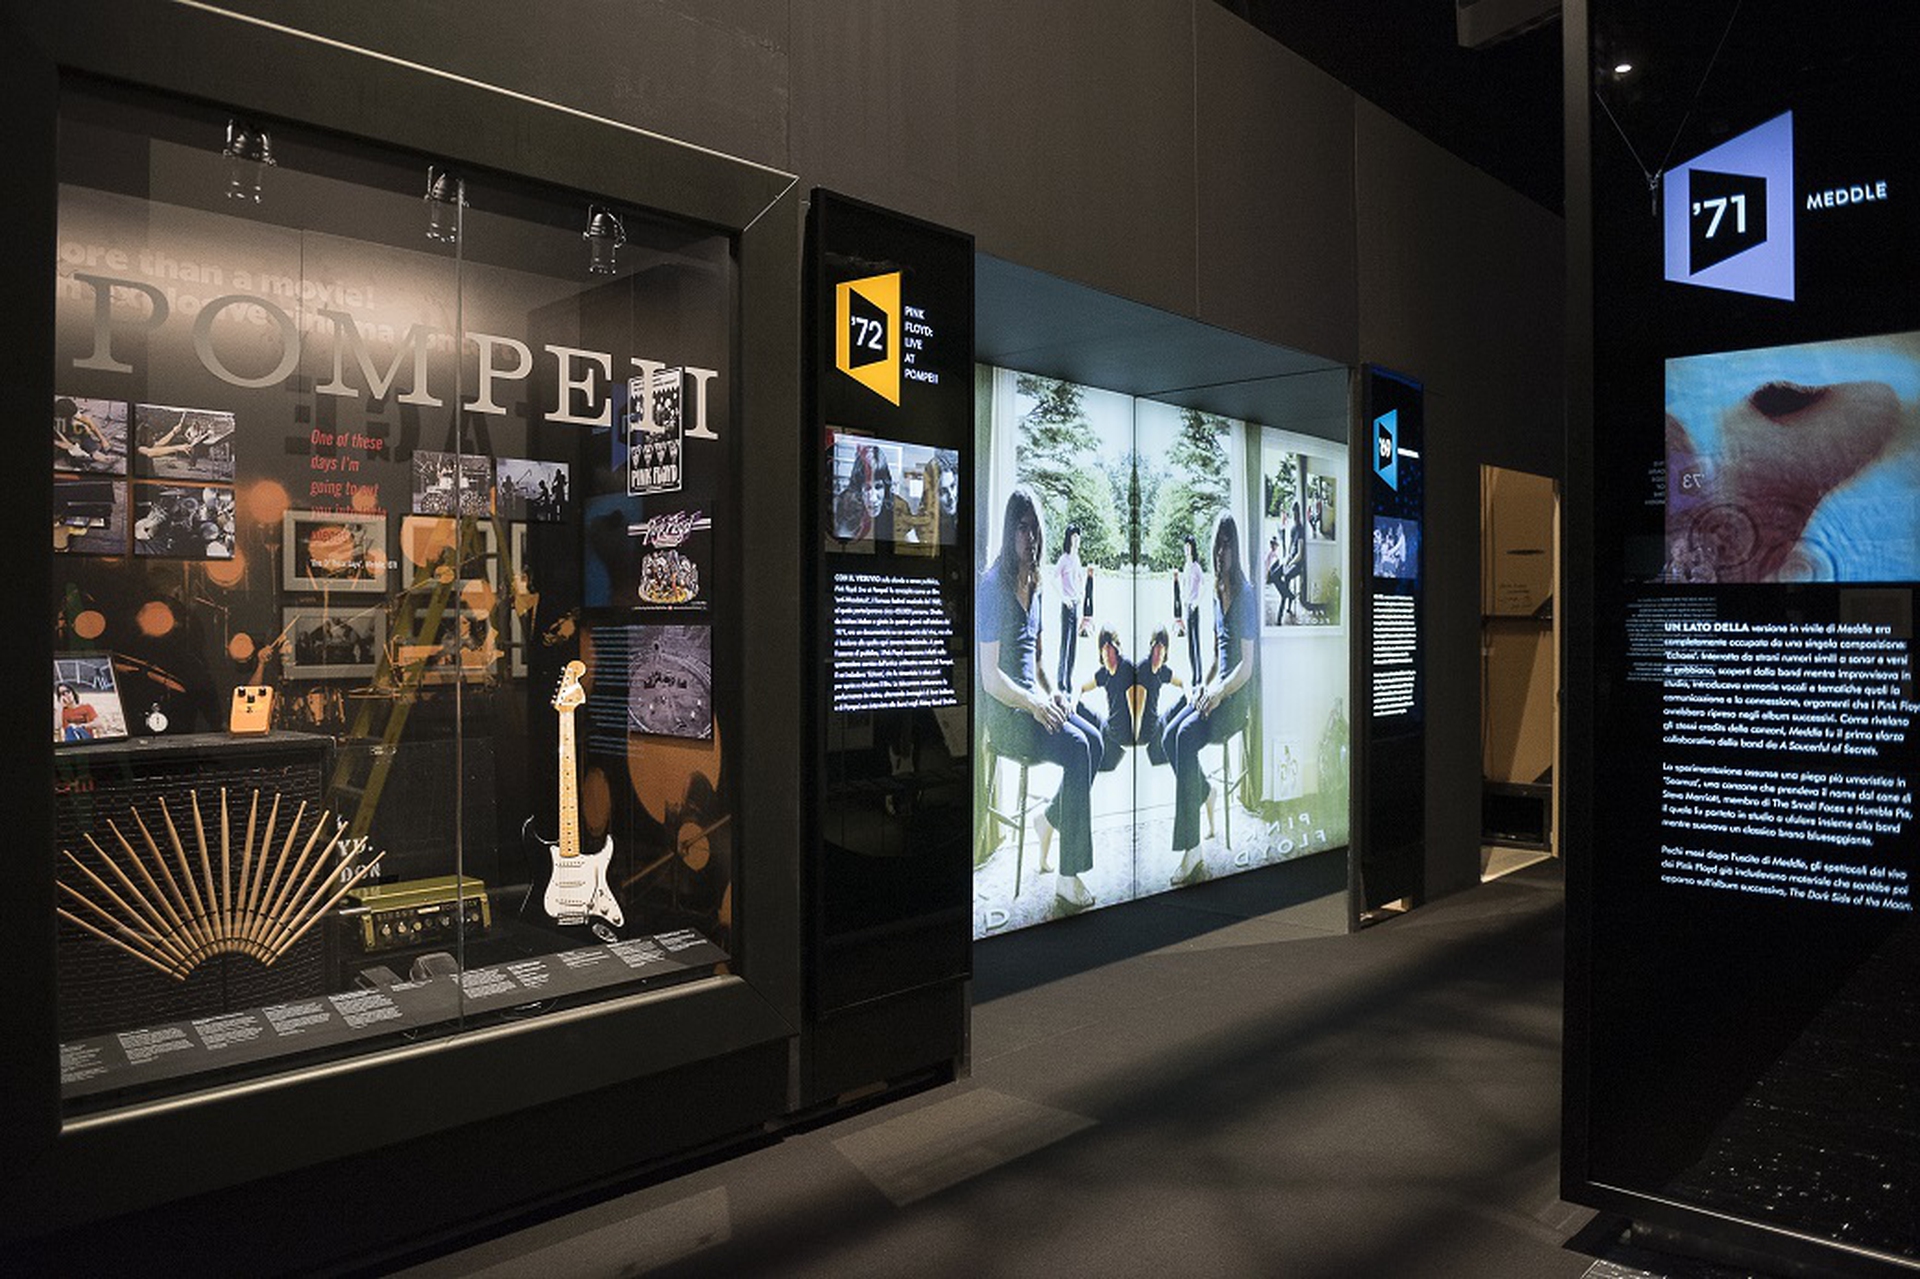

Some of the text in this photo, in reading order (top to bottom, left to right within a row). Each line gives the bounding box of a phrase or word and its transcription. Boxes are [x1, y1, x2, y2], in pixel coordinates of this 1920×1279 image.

[1806, 180, 1888, 211] MEDDLE
[1692, 193, 1746, 239] '71
[139, 249, 224, 287] than
[232, 269, 252, 292] a
[260, 274, 375, 310] movie!
[904, 305, 925, 320] PINK
[851, 315, 883, 351] '72
[904, 321, 934, 338] FLOYD:
[904, 337, 923, 351] LIVE
[73, 272, 719, 440] POMPEII
[904, 352, 916, 364] AT
[904, 368, 939, 385] POMPEII
[310, 428, 384, 450] One of these
[310, 454, 360, 472] days I'm
[310, 480, 342, 498] going
[345, 481, 358, 496] to
[1664, 622, 1681, 632] UN
[1682, 622, 1712, 632] LATO
[1713, 622, 1750, 633] DELLA
